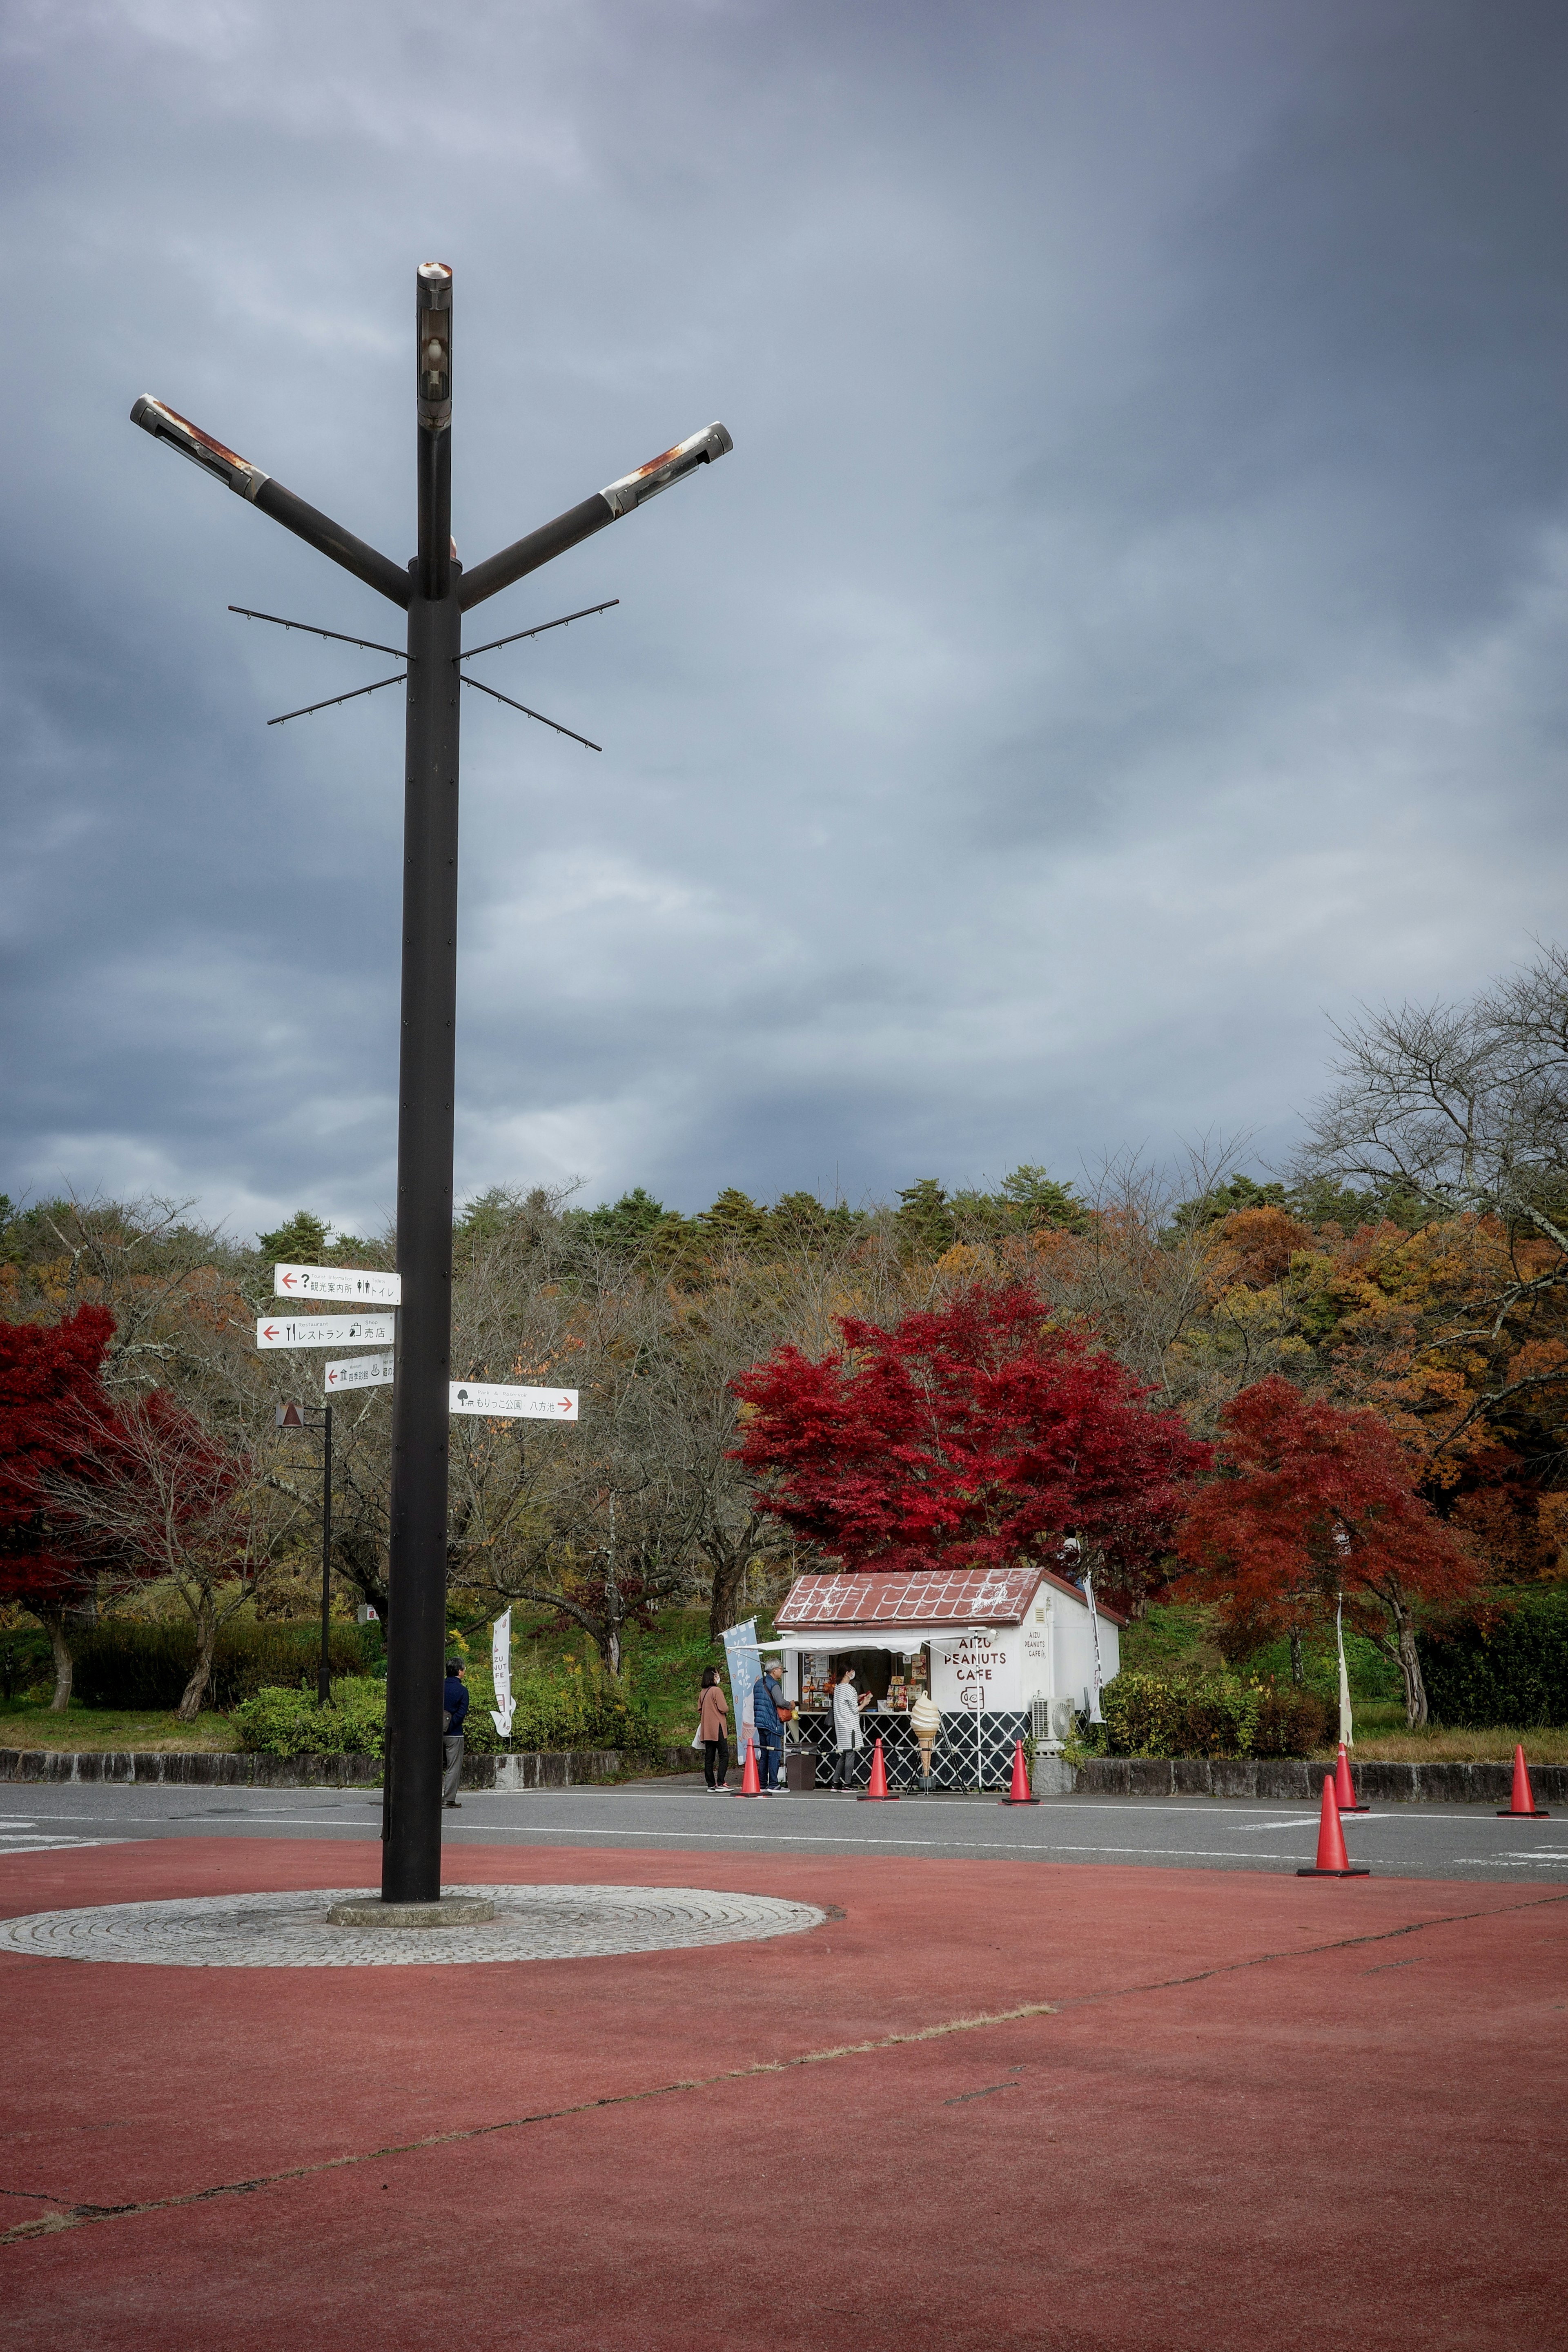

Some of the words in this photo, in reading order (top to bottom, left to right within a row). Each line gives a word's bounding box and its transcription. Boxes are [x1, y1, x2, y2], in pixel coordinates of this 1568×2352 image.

[310, 1281, 352, 1294] 観光案内所
[372, 1286, 394, 1297] トイレ
[299, 1330, 343, 1340] レストラン
[364, 1327, 385, 1338] 売店
[349, 1370, 368, 1382] 四季彩館
[382, 1366, 394, 1379] 蔵の
[477, 1397, 522, 1410] もりっこ公園
[530, 1401, 555, 1412] 八方池
[959, 1637, 991, 1648] AIZU
[944, 1652, 1007, 1665] PEANUTS
[956, 1669, 992, 1681] CAFE
